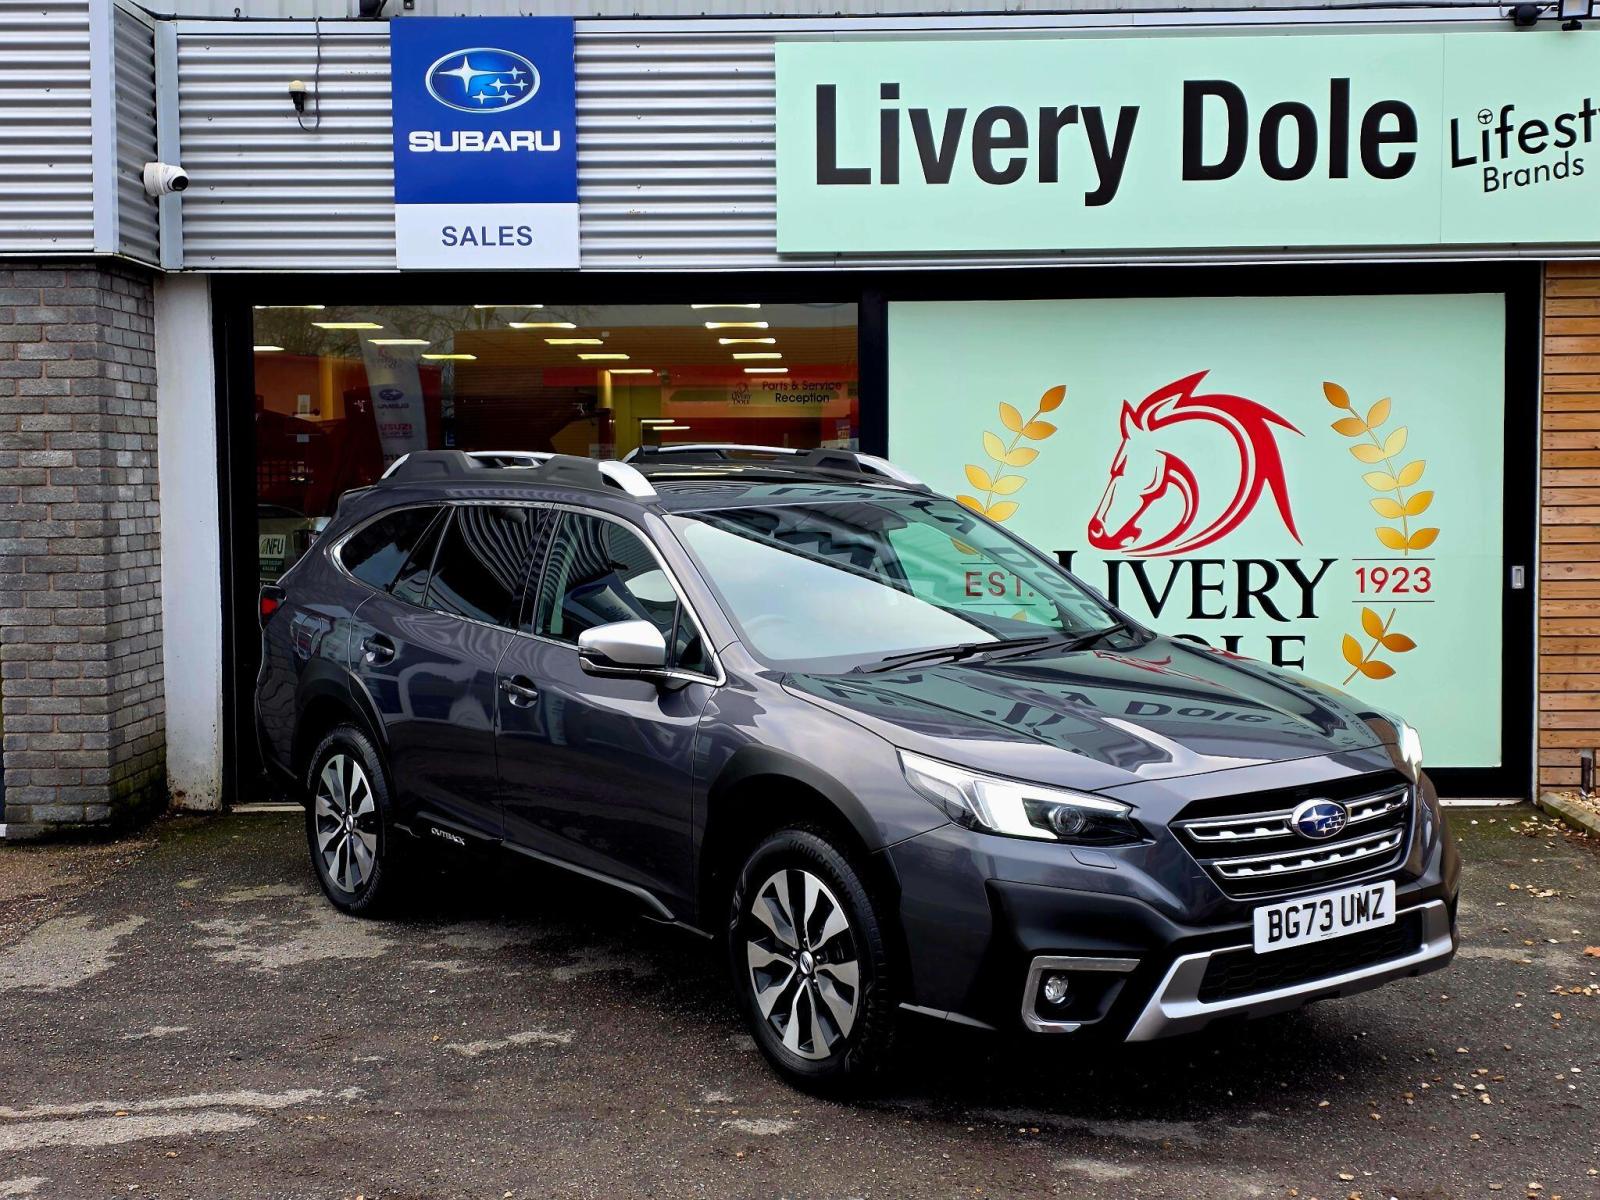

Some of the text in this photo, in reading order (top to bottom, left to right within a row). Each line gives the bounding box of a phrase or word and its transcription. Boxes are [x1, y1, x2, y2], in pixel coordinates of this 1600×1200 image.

[408, 130, 562, 153] SUBARU
[816, 77, 1418, 207] Livery Dole
[1450, 97, 1600, 169] Lifest
[1483, 151, 1585, 193] Brands
[441, 225, 533, 247] SALES
[762, 381, 842, 391] Parts & Service
[775, 392, 830, 404] Reception
[266, 538, 284, 555] NFU
[965, 566, 1433, 598] EST. 1923
[1267, 886, 1385, 944] BG73 UMZ
